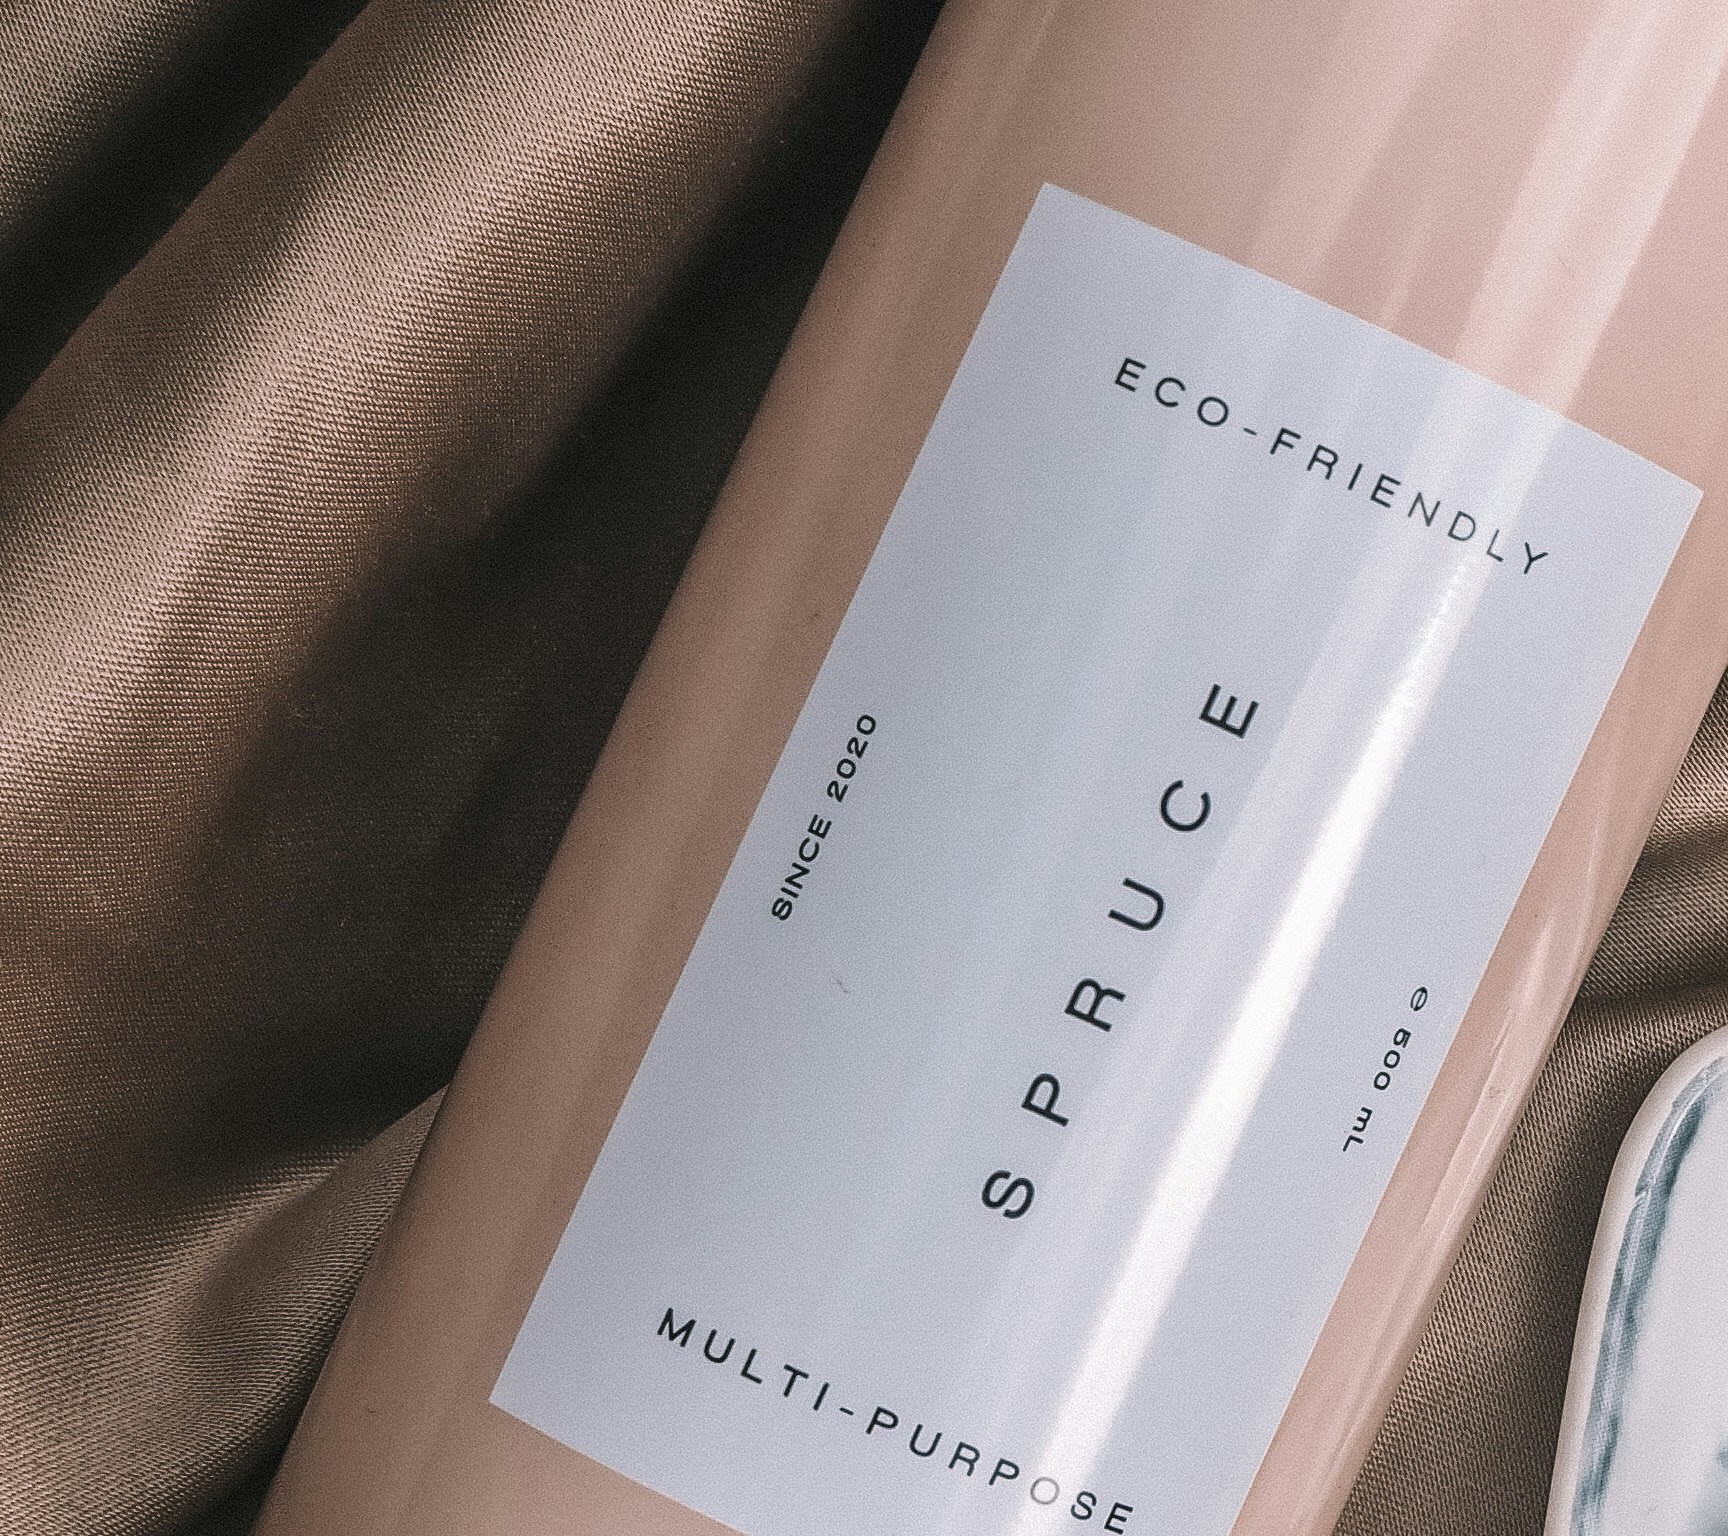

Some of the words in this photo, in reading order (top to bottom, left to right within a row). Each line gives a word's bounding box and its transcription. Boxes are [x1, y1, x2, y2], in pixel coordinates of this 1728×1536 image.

[1113, 356, 1550, 576] ECO-FRIENDLY
[770, 813, 833, 922] SINCE
[826, 713, 878, 804] 2020
[980, 683, 1260, 1220] SPRUCE
[1341, 1106, 1374, 1153] mL
[1372, 1027, 1412, 1092] 500
[656, 1306, 1134, 1536] MULTI-PURPOSE
